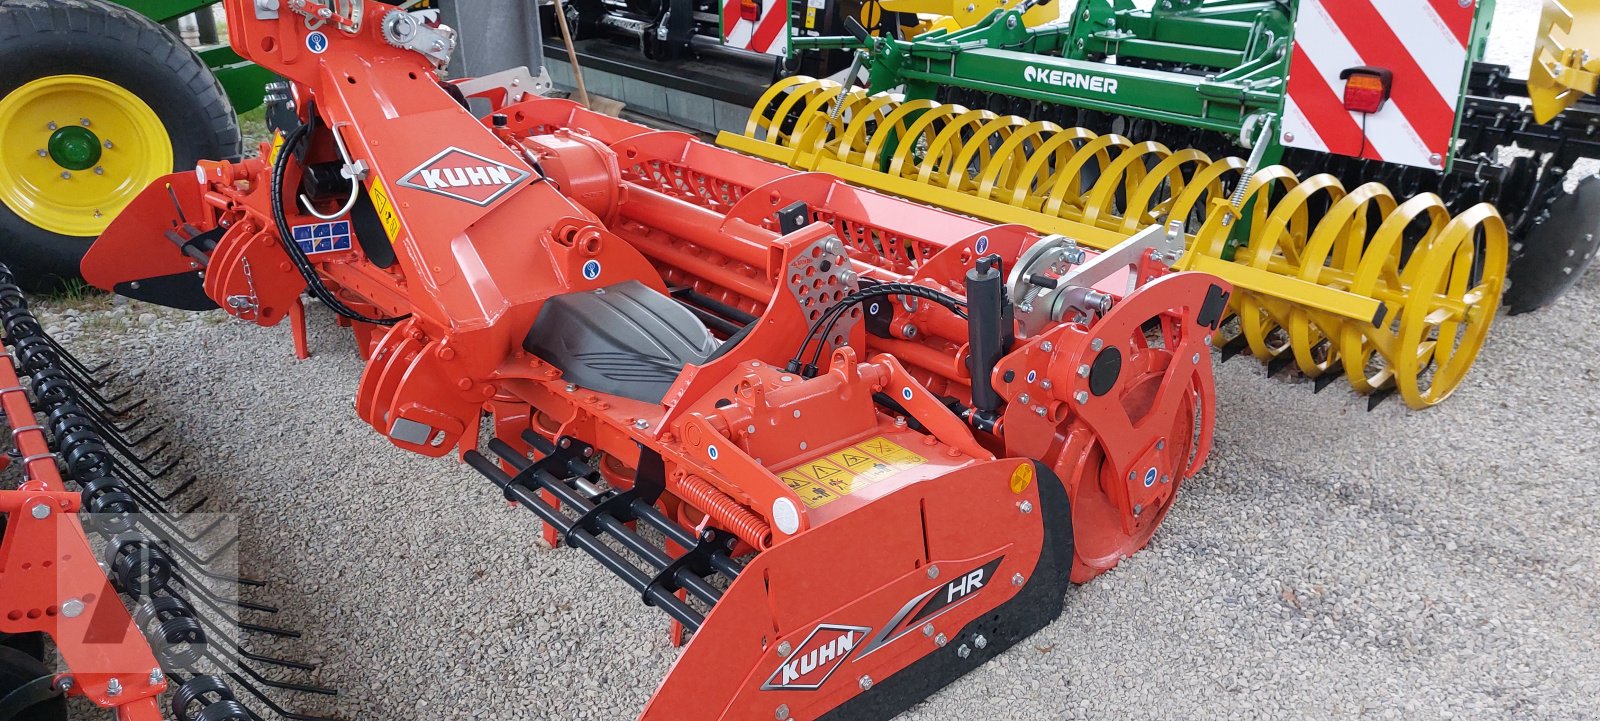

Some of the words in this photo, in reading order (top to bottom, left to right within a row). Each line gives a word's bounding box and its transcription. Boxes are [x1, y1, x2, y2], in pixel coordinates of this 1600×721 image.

[1037, 68, 1117, 94] KERNER
[420, 166, 512, 189] KUHN
[947, 568, 984, 603] HR
[782, 630, 854, 686] KUHN
